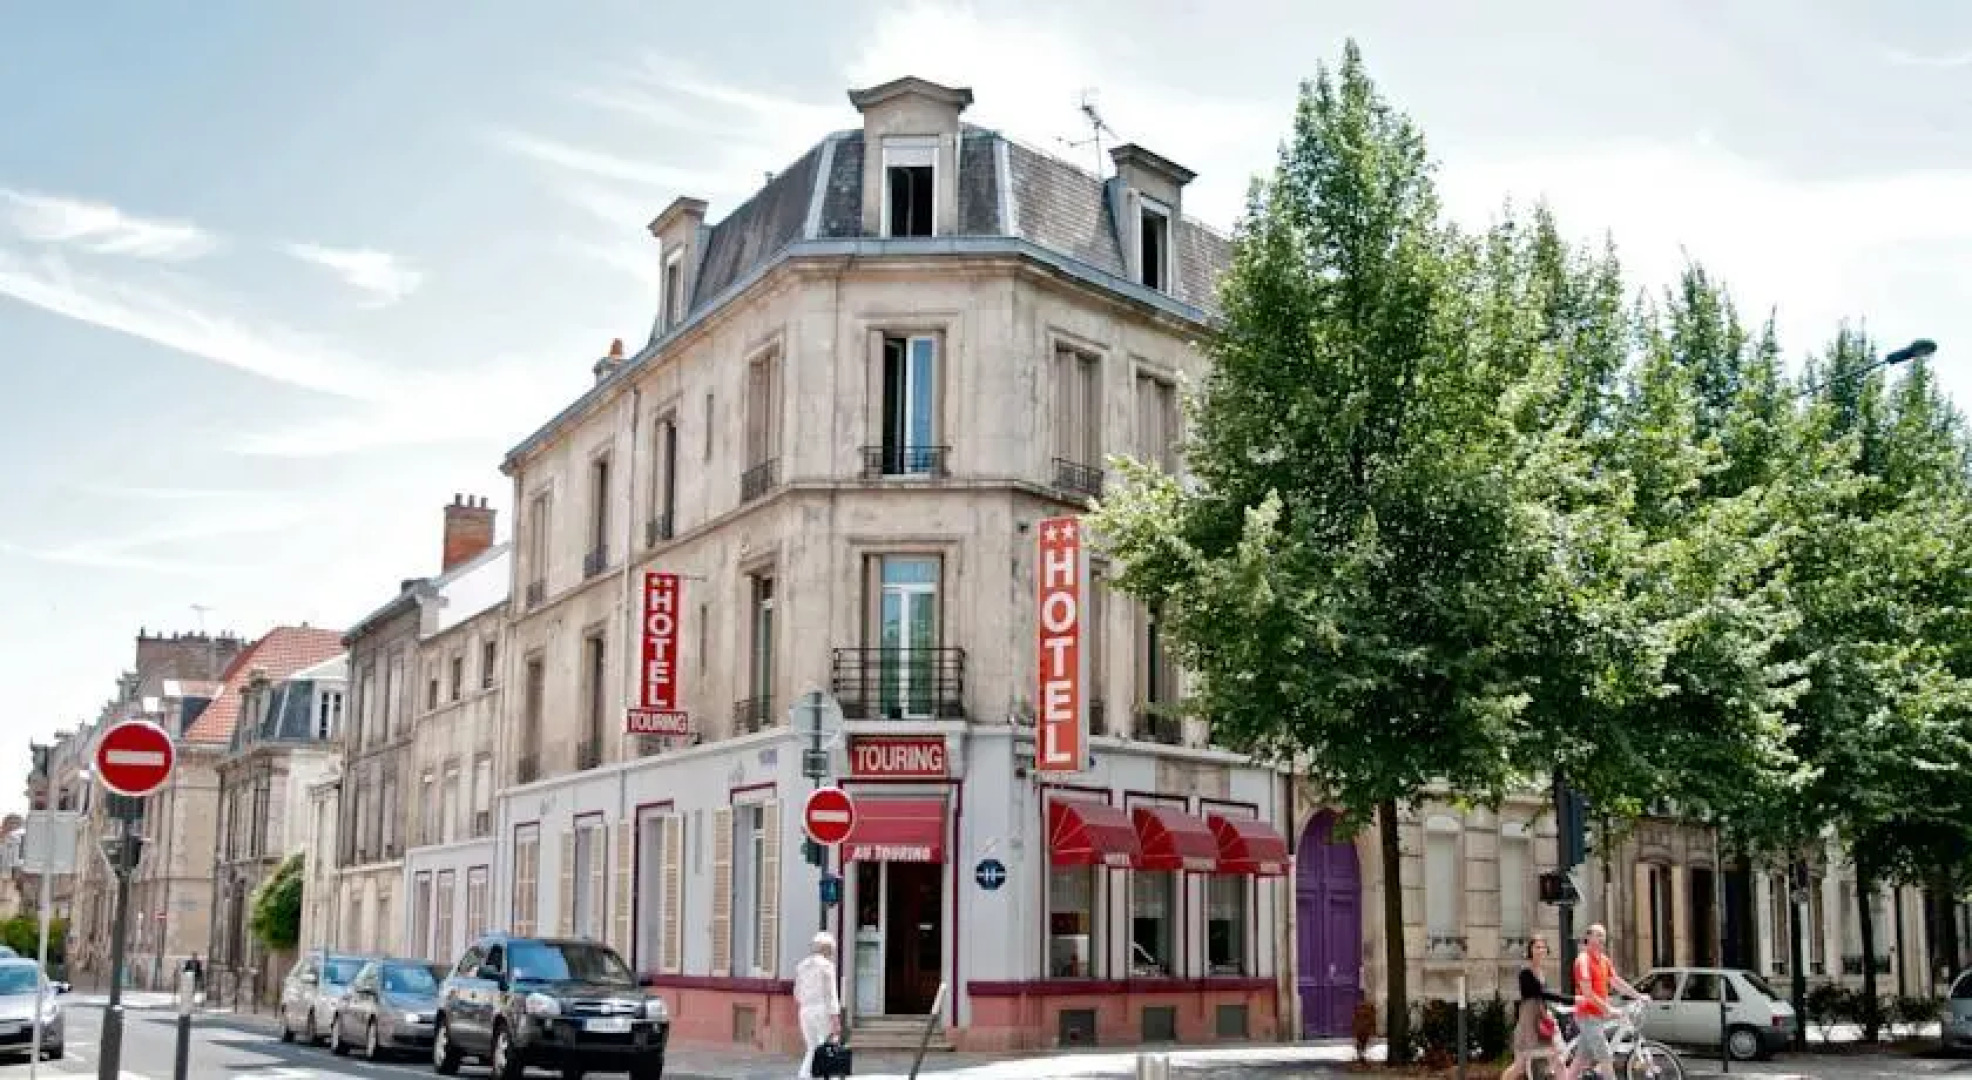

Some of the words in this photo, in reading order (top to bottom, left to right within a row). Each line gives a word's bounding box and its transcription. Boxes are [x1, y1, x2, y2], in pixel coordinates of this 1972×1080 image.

[648, 588, 674, 707] HOTEL
[1042, 548, 1077, 764] HOTEL
[630, 713, 686, 733] TOURING
[855, 745, 943, 771] TOURING
